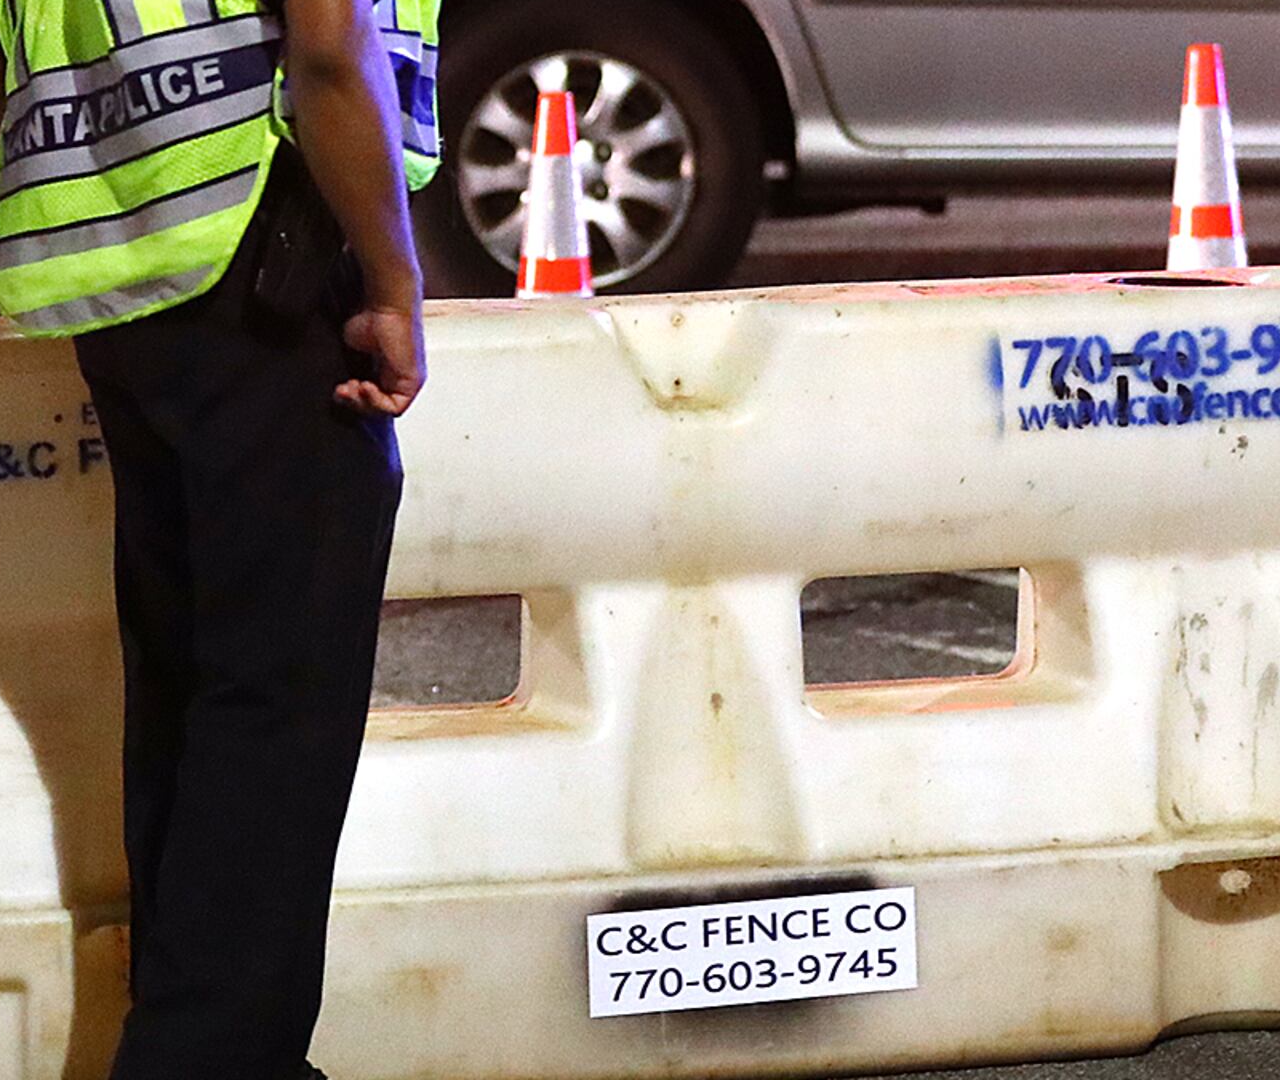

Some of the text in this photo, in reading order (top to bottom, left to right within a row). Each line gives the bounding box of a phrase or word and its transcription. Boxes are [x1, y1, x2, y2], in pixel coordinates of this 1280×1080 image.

[596, 902, 907, 956] C&C FENCE CO
[609, 947, 898, 1002] 770-603-9745
